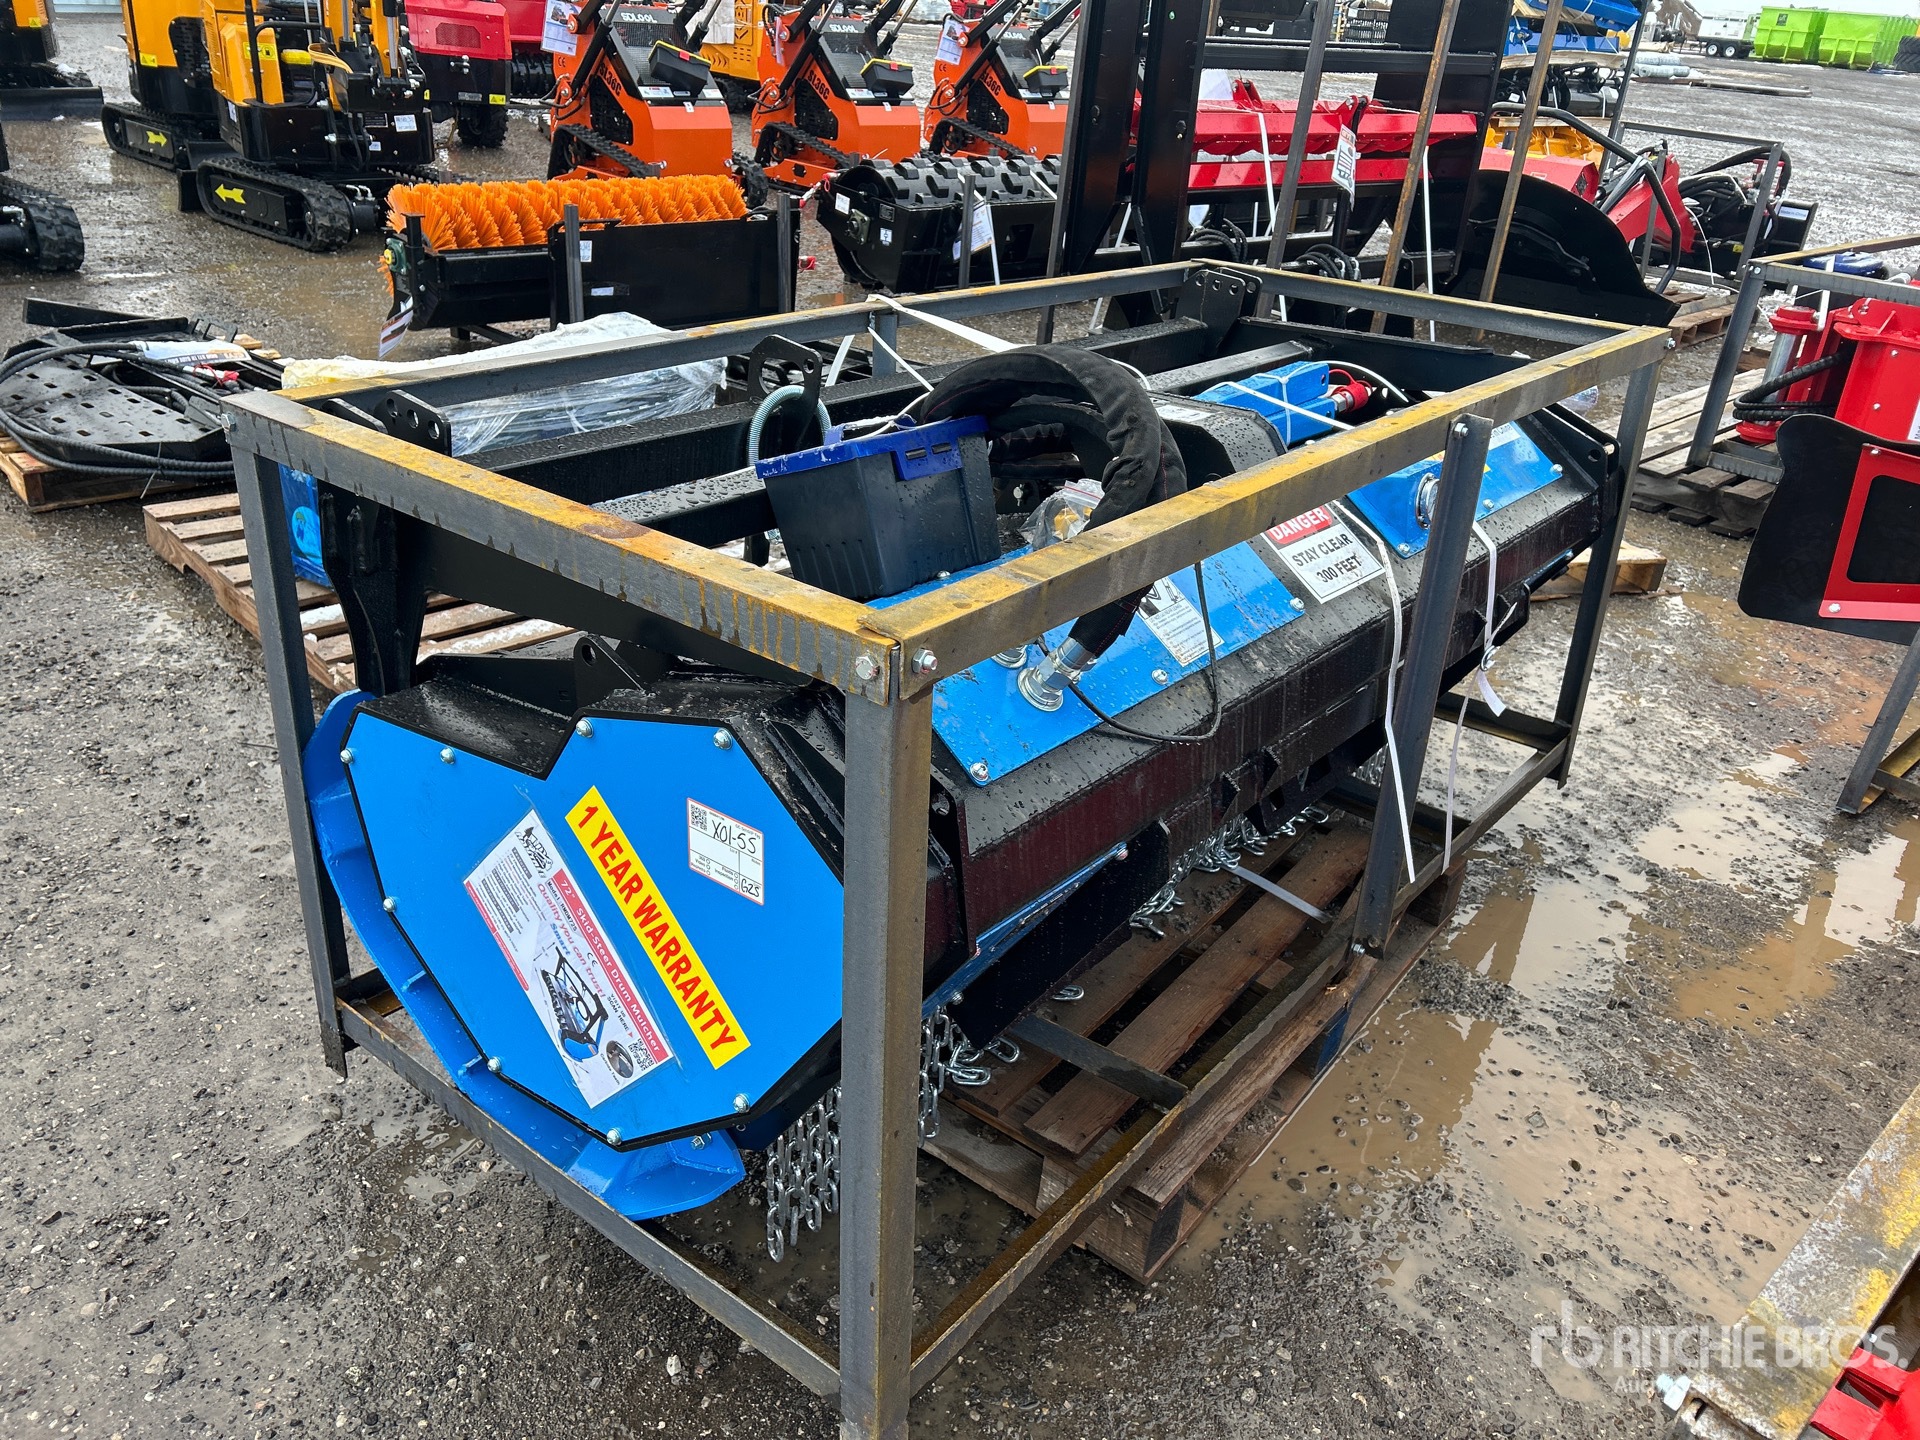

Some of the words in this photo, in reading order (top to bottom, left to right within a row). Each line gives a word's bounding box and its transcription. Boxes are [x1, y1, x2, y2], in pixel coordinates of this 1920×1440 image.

[599, 62, 622, 96] SL36C
[807, 69, 830, 99] SL36C
[1270, 508, 1329, 540] DANGER
[1292, 546, 1321, 567] STAY
[1319, 533, 1353, 556] CLEAR
[1316, 566, 1339, 583] 300
[1334, 554, 1362, 575] FEET
[536, 881, 563, 923] Quality
[559, 922, 574, 945] you
[572, 944, 586, 965] can
[585, 966, 606, 999] trust!
[549, 921, 571, 956] Smart
[578, 805, 598, 828] 1
[591, 821, 643, 904] YEAR
[633, 895, 738, 1054] WARRANTY
[560, 878, 575, 901] 72"
[575, 906, 613, 968] Skid-Steer
[610, 968, 632, 1002] Drum
[629, 1002, 661, 1052] Mulcher
